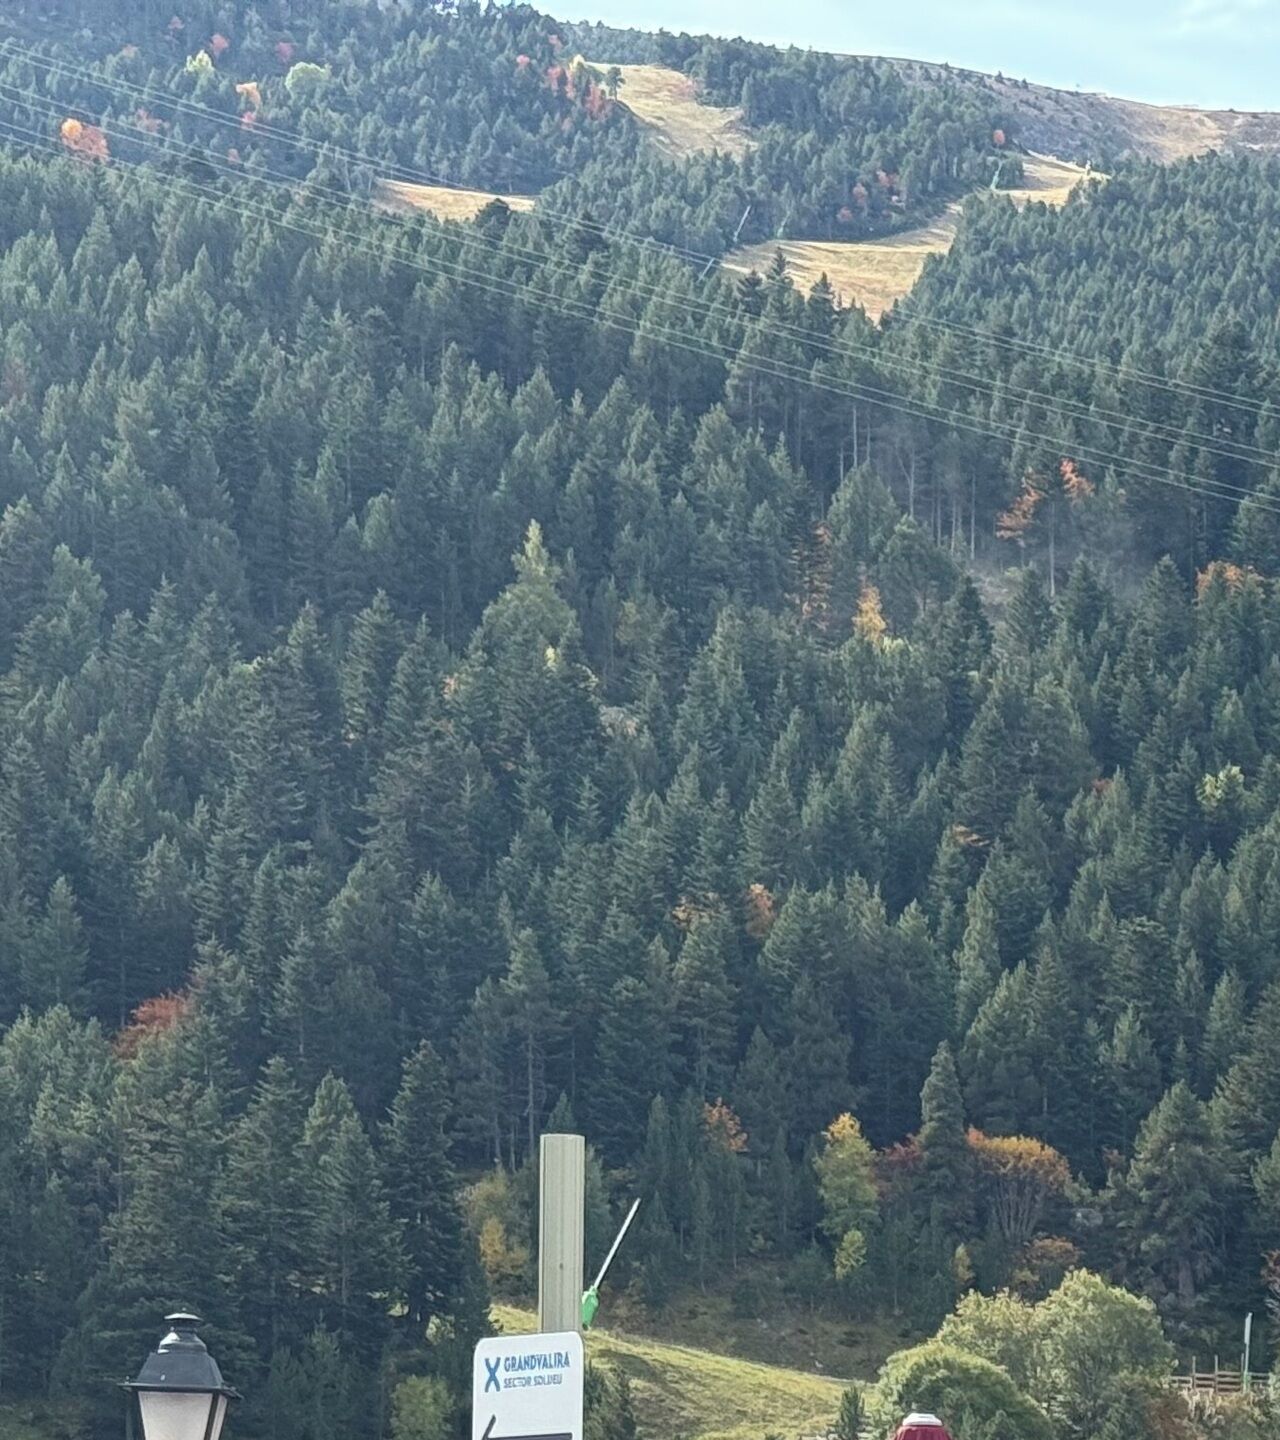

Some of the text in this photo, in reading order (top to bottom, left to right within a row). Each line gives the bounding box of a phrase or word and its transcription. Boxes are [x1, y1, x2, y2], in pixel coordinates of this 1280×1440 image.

[504, 1351, 570, 1373] GRANDVALIRA
[503, 1373, 563, 1389] SECTOR SOLDEU
